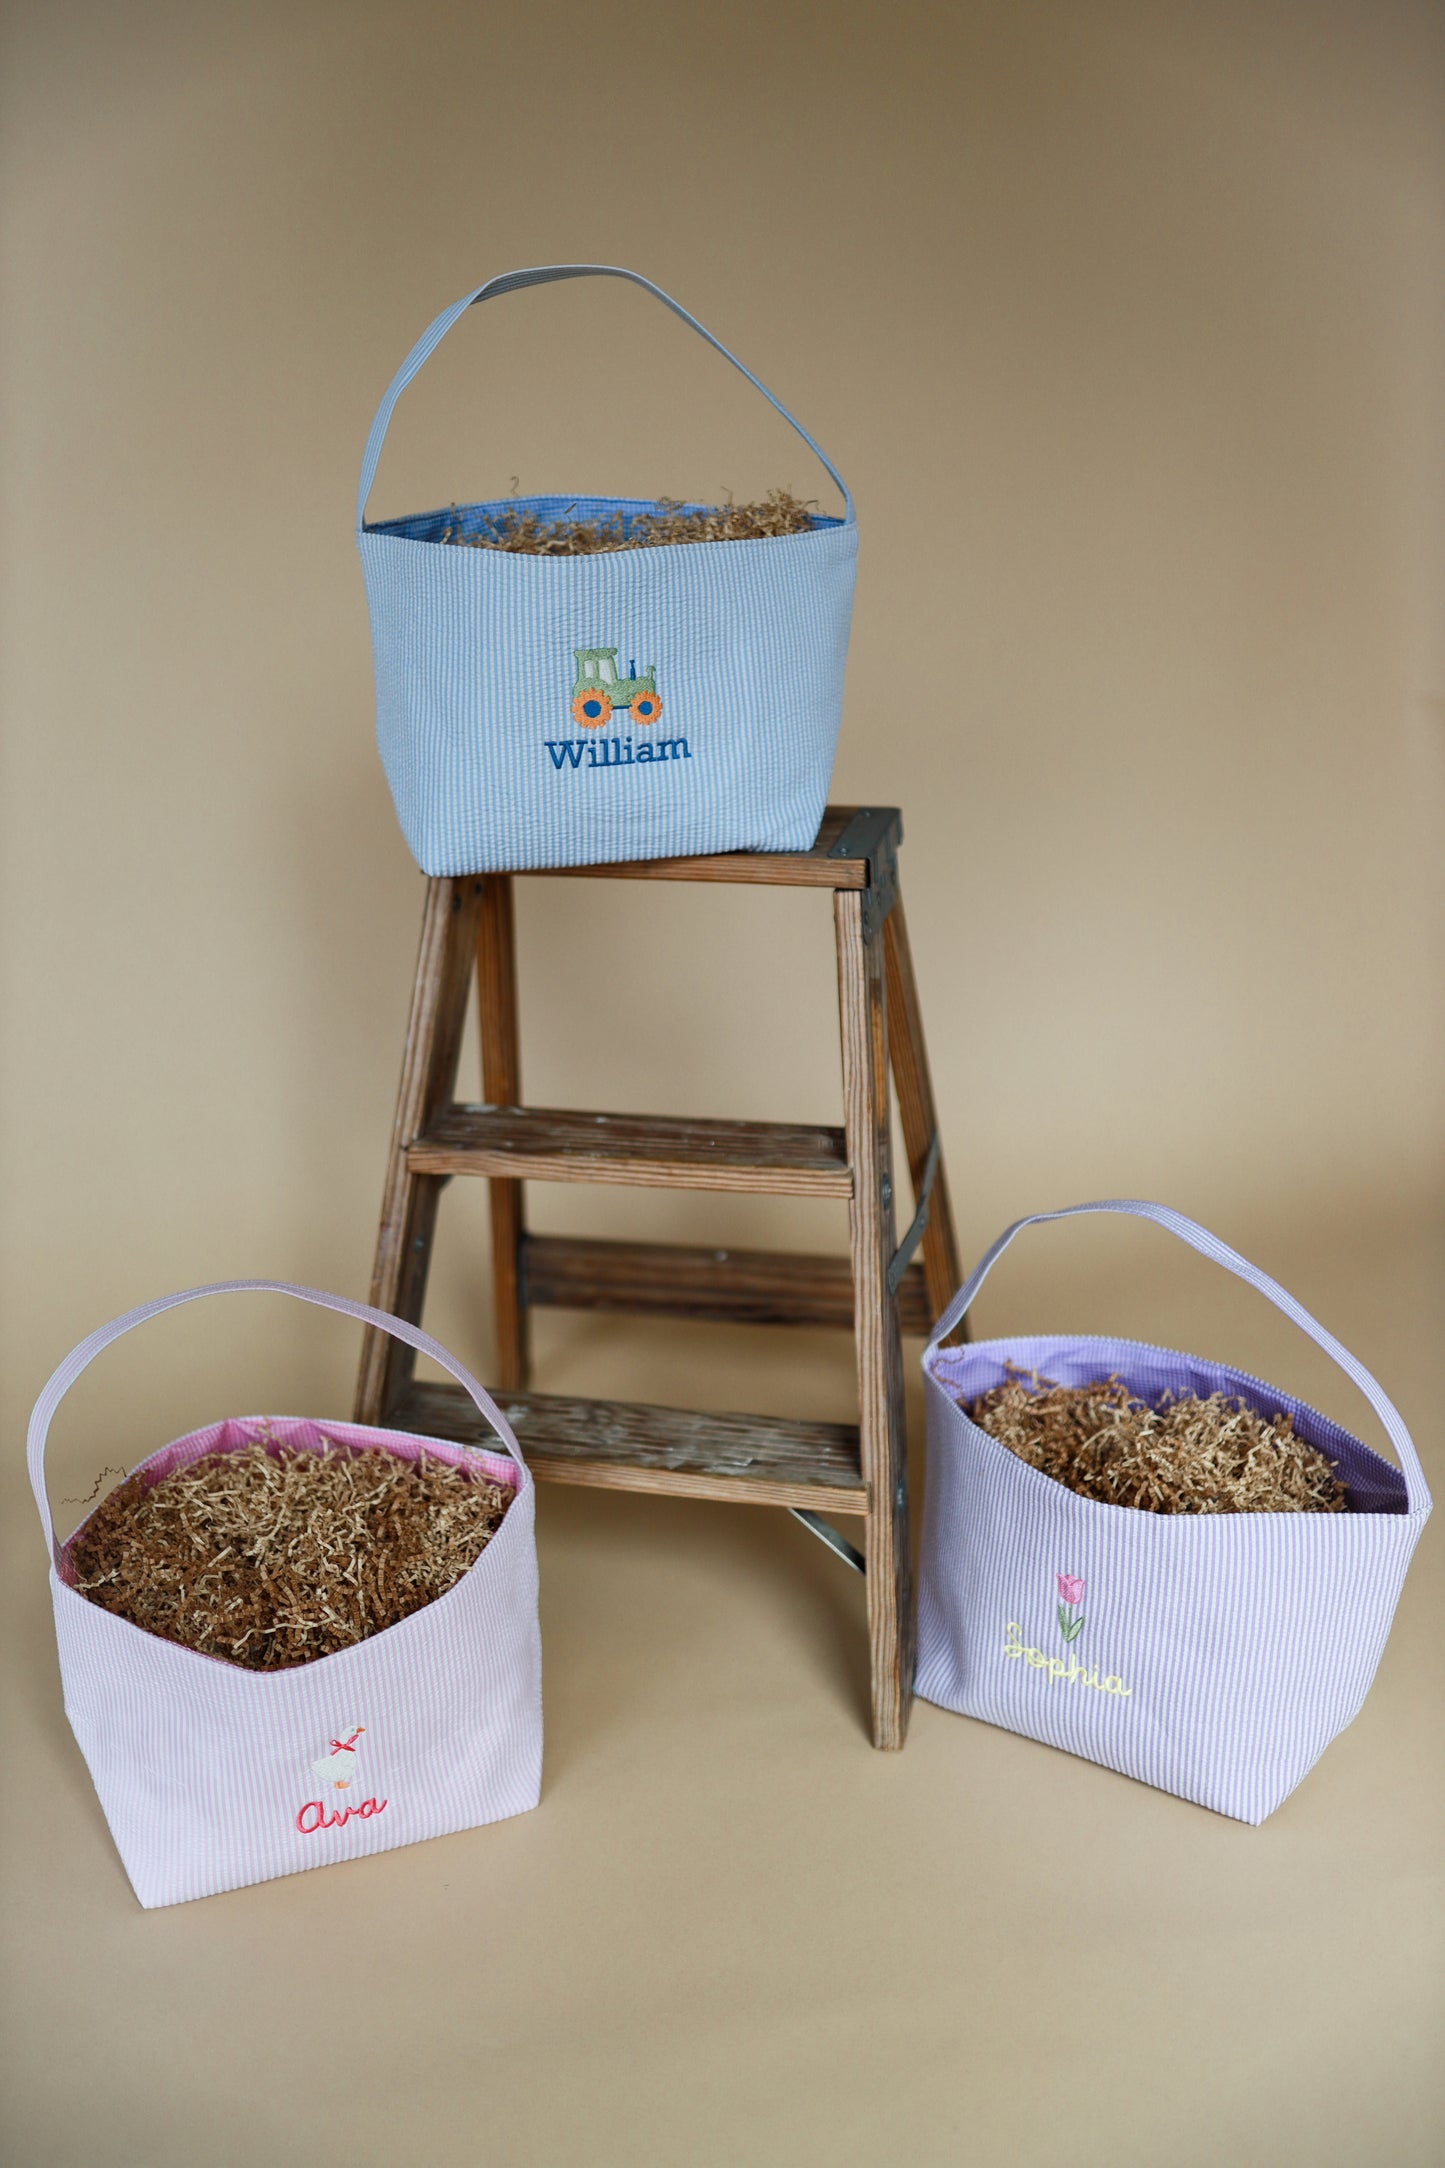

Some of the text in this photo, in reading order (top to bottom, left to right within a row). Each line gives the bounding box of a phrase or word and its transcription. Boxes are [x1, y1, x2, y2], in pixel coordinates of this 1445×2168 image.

[544, 736, 692, 770] William
[1004, 1622, 1133, 1697] Sophia
[296, 1797, 388, 1834] Ava
